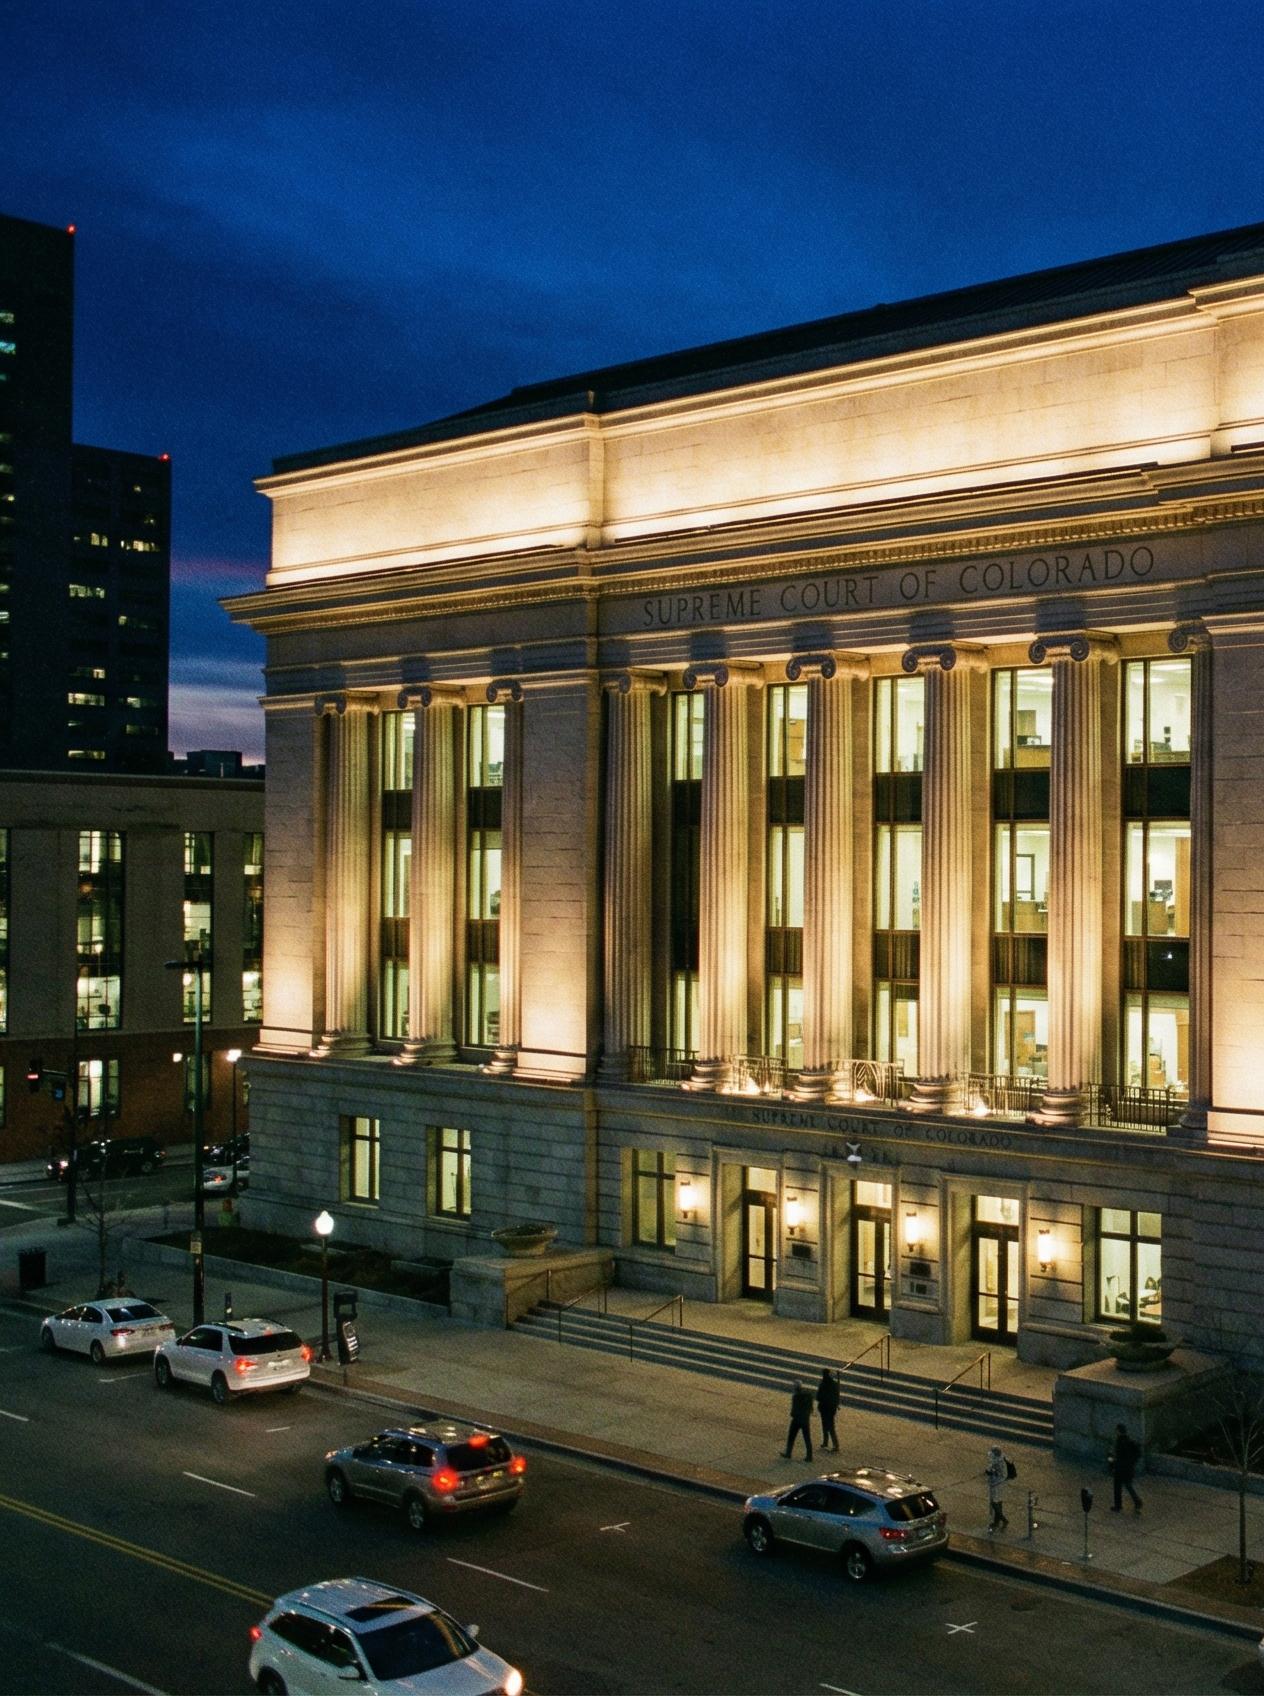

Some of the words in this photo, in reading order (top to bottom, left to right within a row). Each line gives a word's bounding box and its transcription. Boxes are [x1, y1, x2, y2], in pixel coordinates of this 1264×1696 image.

[643, 590, 762, 626] SUPREME
[780, 575, 880, 611] COURT
[899, 569, 937, 601] OF
[958, 546, 1155, 594] COLORADO
[752, 1110, 816, 1129] SUPREME
[827, 1117, 881, 1135] COURT
[925, 1127, 1012, 1148] COLORADO
